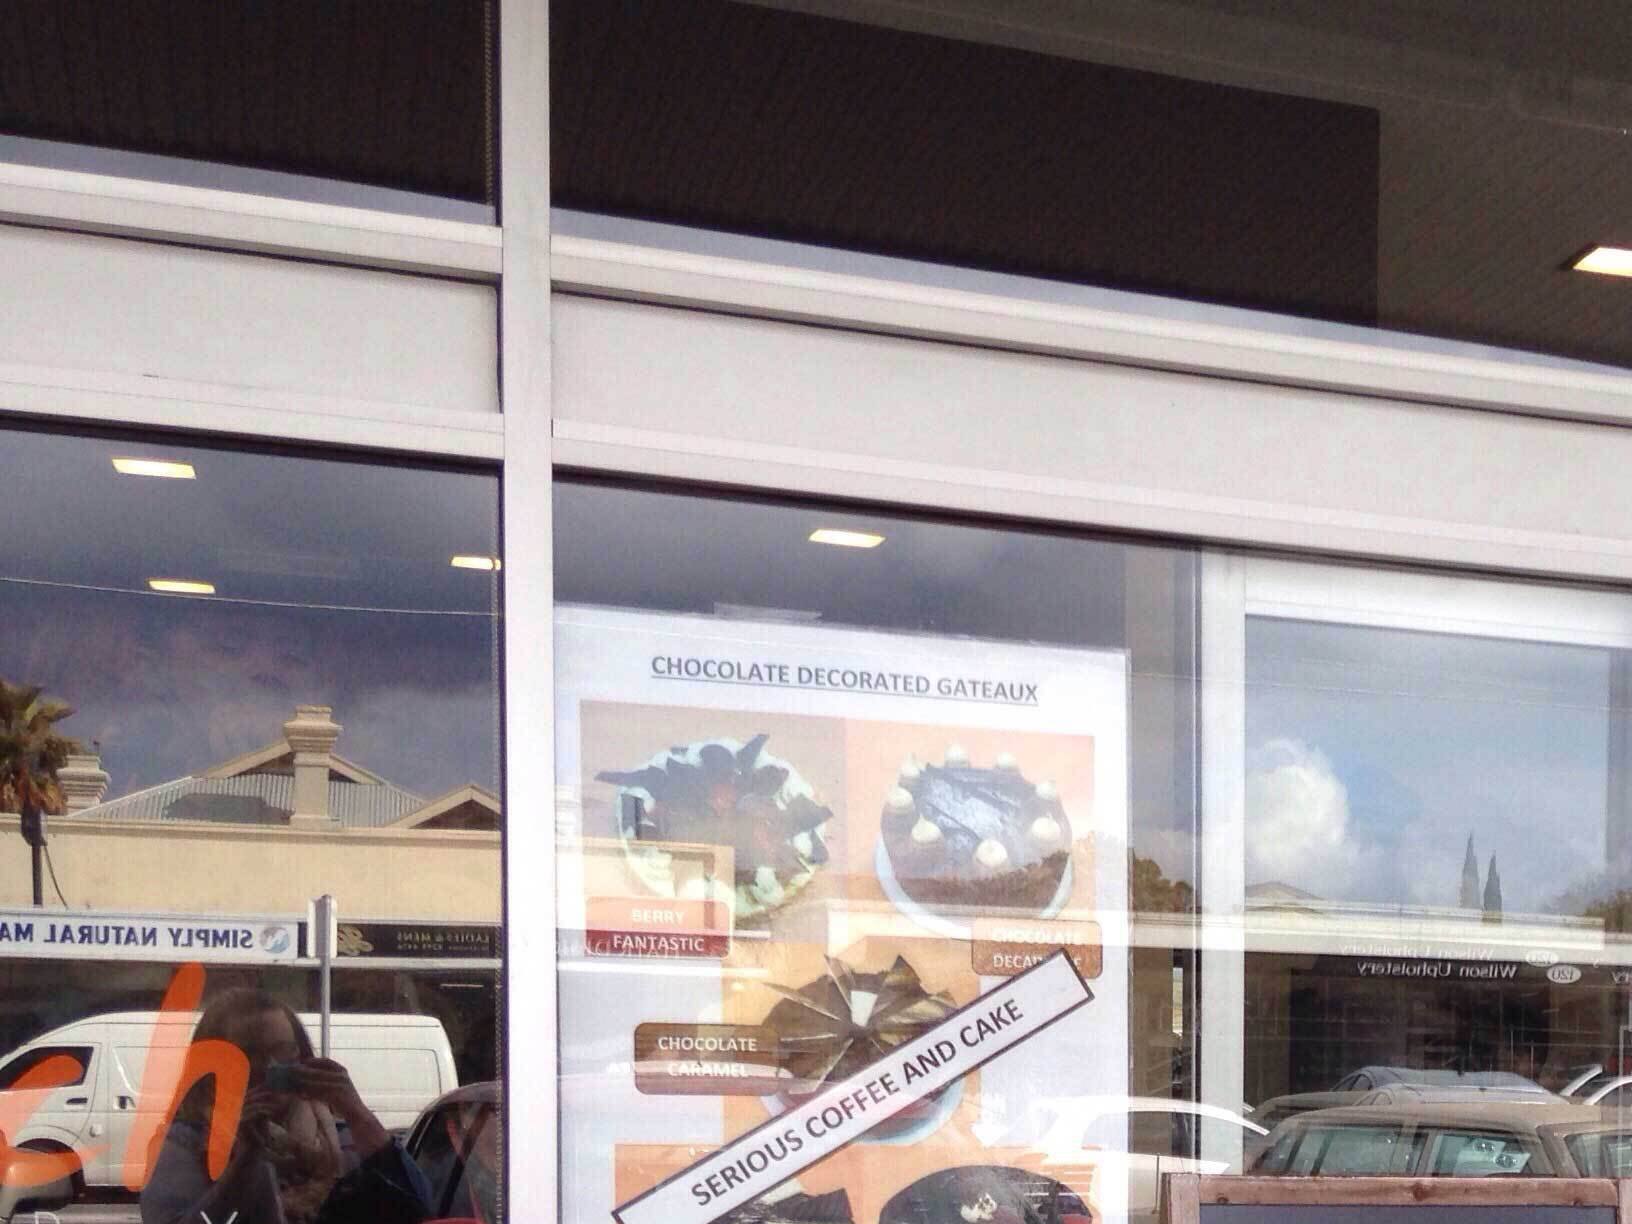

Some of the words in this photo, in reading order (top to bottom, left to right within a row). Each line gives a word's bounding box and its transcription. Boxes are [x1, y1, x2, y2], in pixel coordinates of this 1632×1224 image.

[650, 655, 790, 685] CHOCOLATE
[797, 665, 931, 696] DECORATED
[937, 676, 1039, 703] GATEAUX
[631, 908, 686, 924] BERRY
[613, 935, 706, 952] FANTASTIC
[657, 1036, 758, 1052] CHOCOLATE
[667, 1062, 750, 1078] CARAMEL
[690, 1132, 804, 1207] SERIOUS
[805, 1078, 901, 1142] COFFEE
[901, 1040, 958, 1086] AND
[958, 997, 1025, 1049] CAKE
